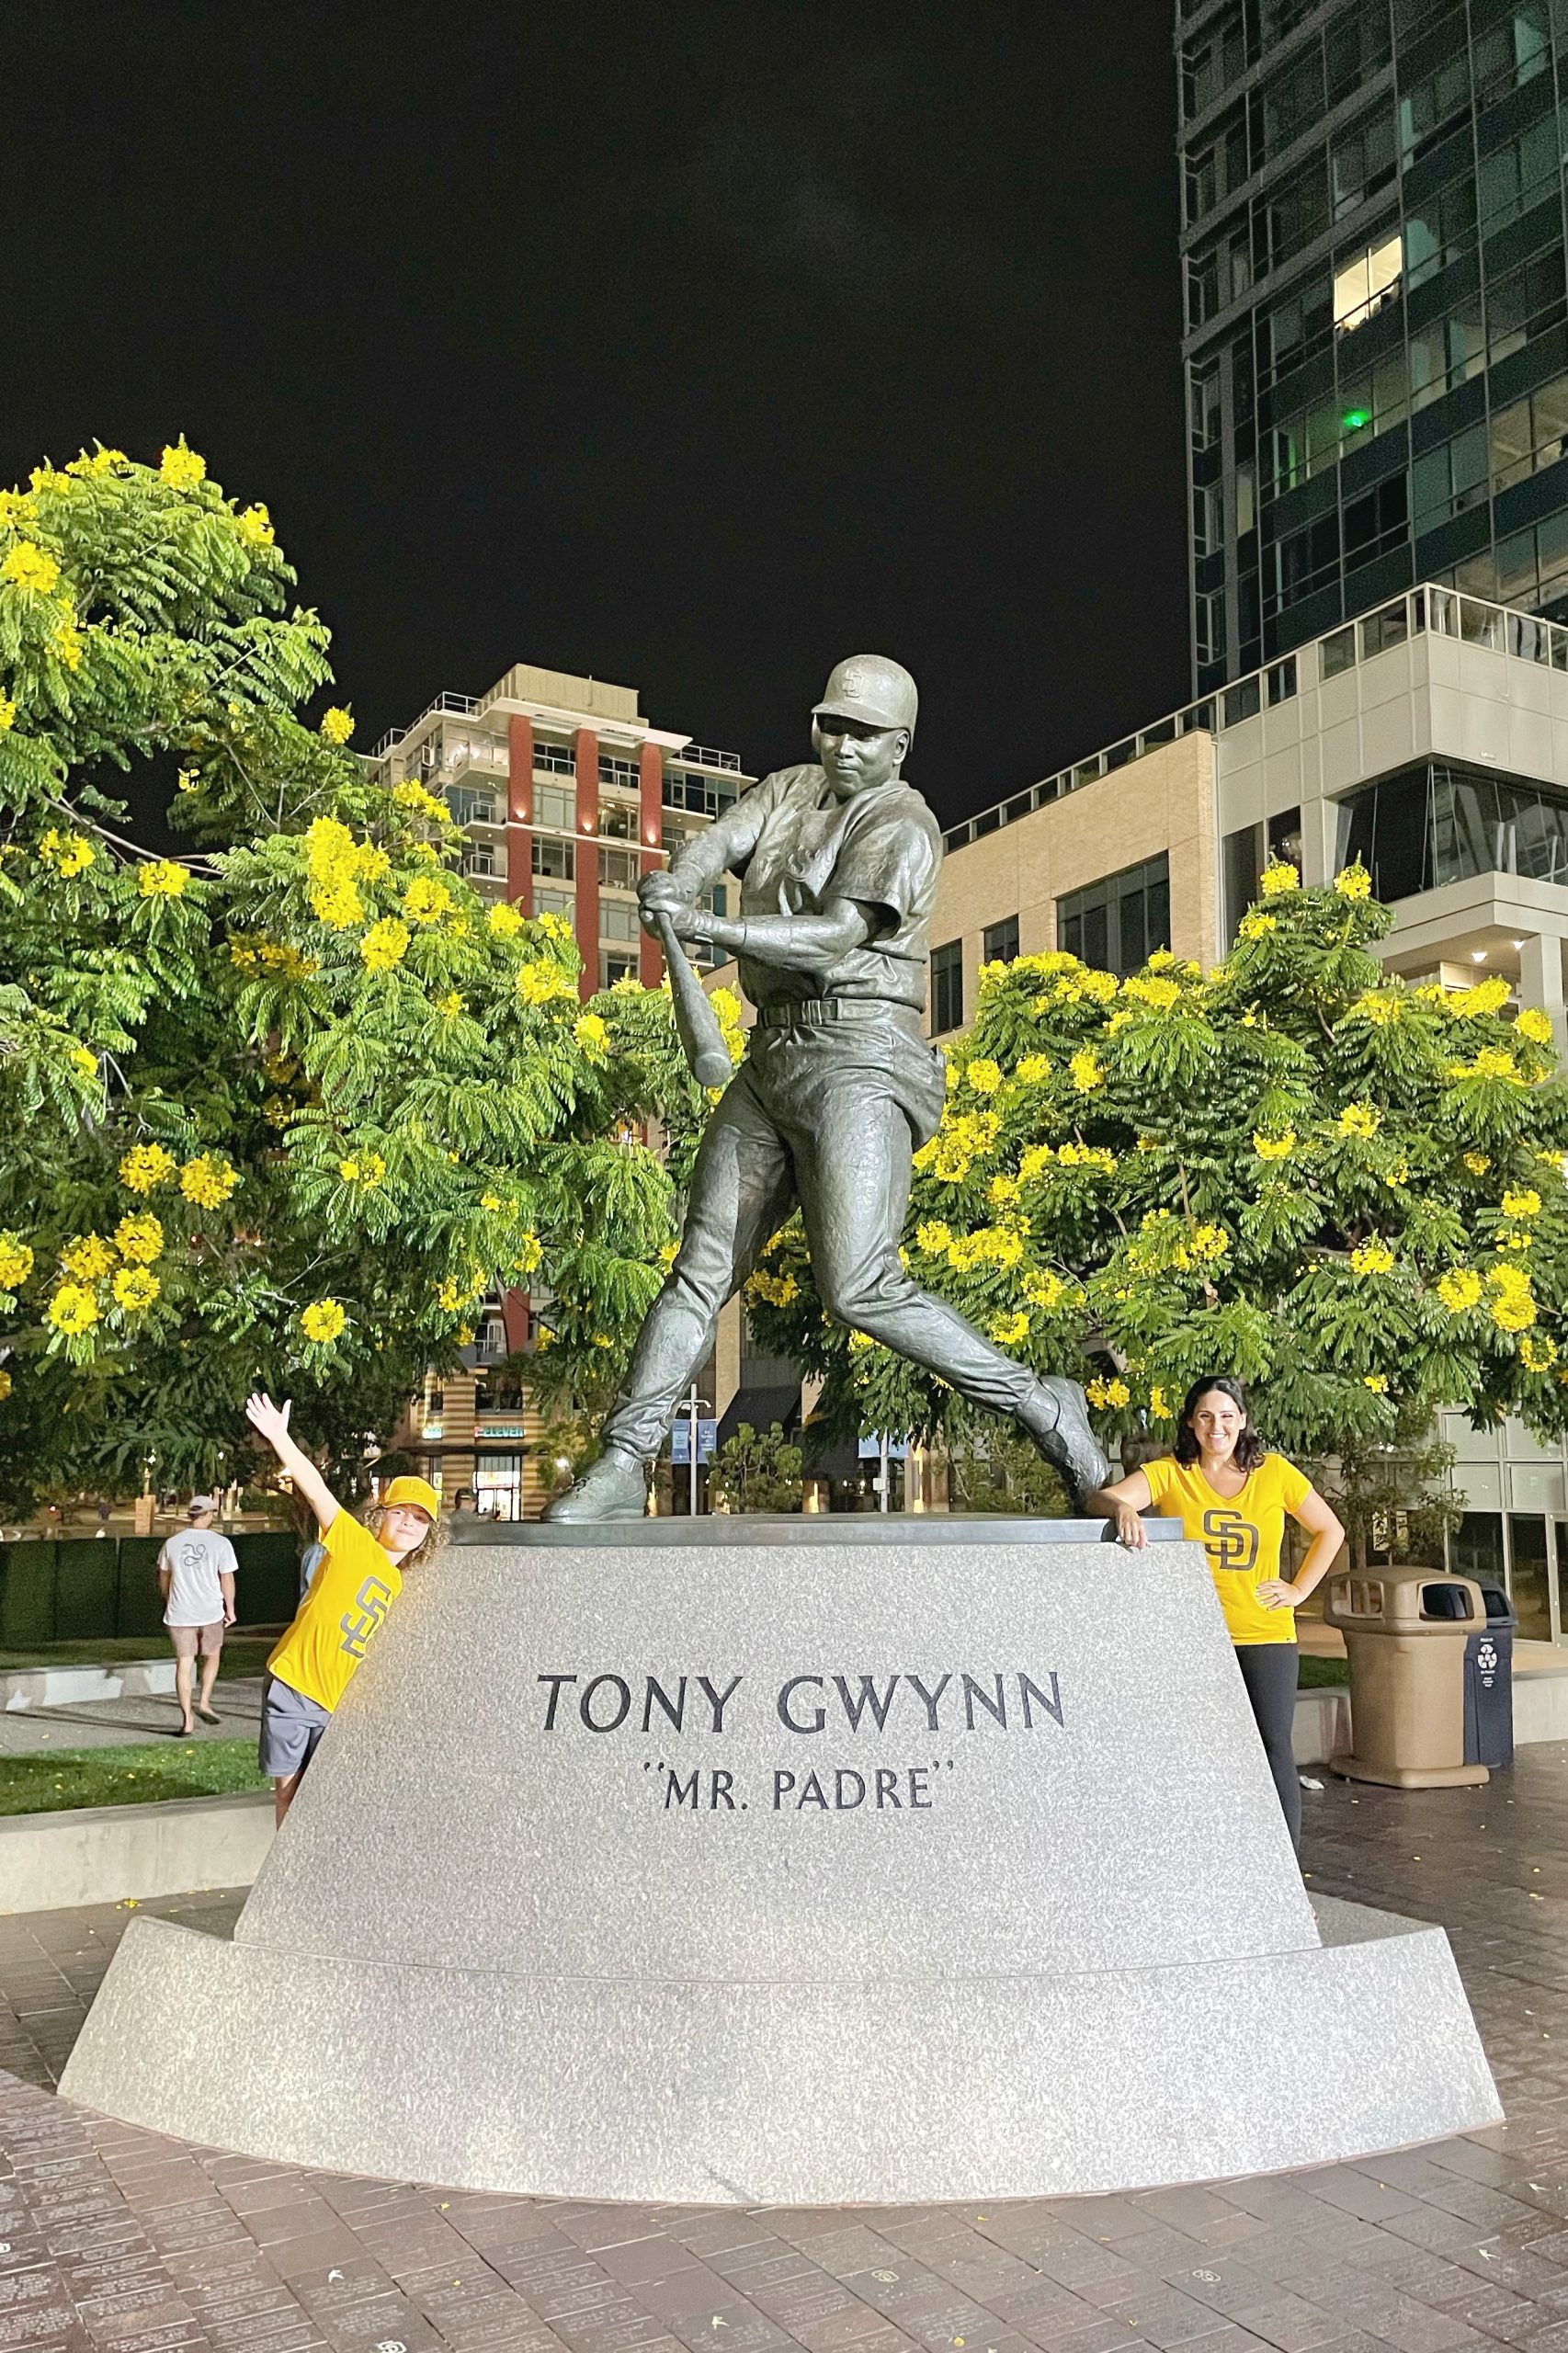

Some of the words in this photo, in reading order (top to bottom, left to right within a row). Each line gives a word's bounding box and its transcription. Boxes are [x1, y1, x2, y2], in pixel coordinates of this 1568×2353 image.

[1203, 1509, 1259, 1572] SD
[537, 1673, 744, 1734] TONY
[777, 1671, 1065, 1734] GWYNN
